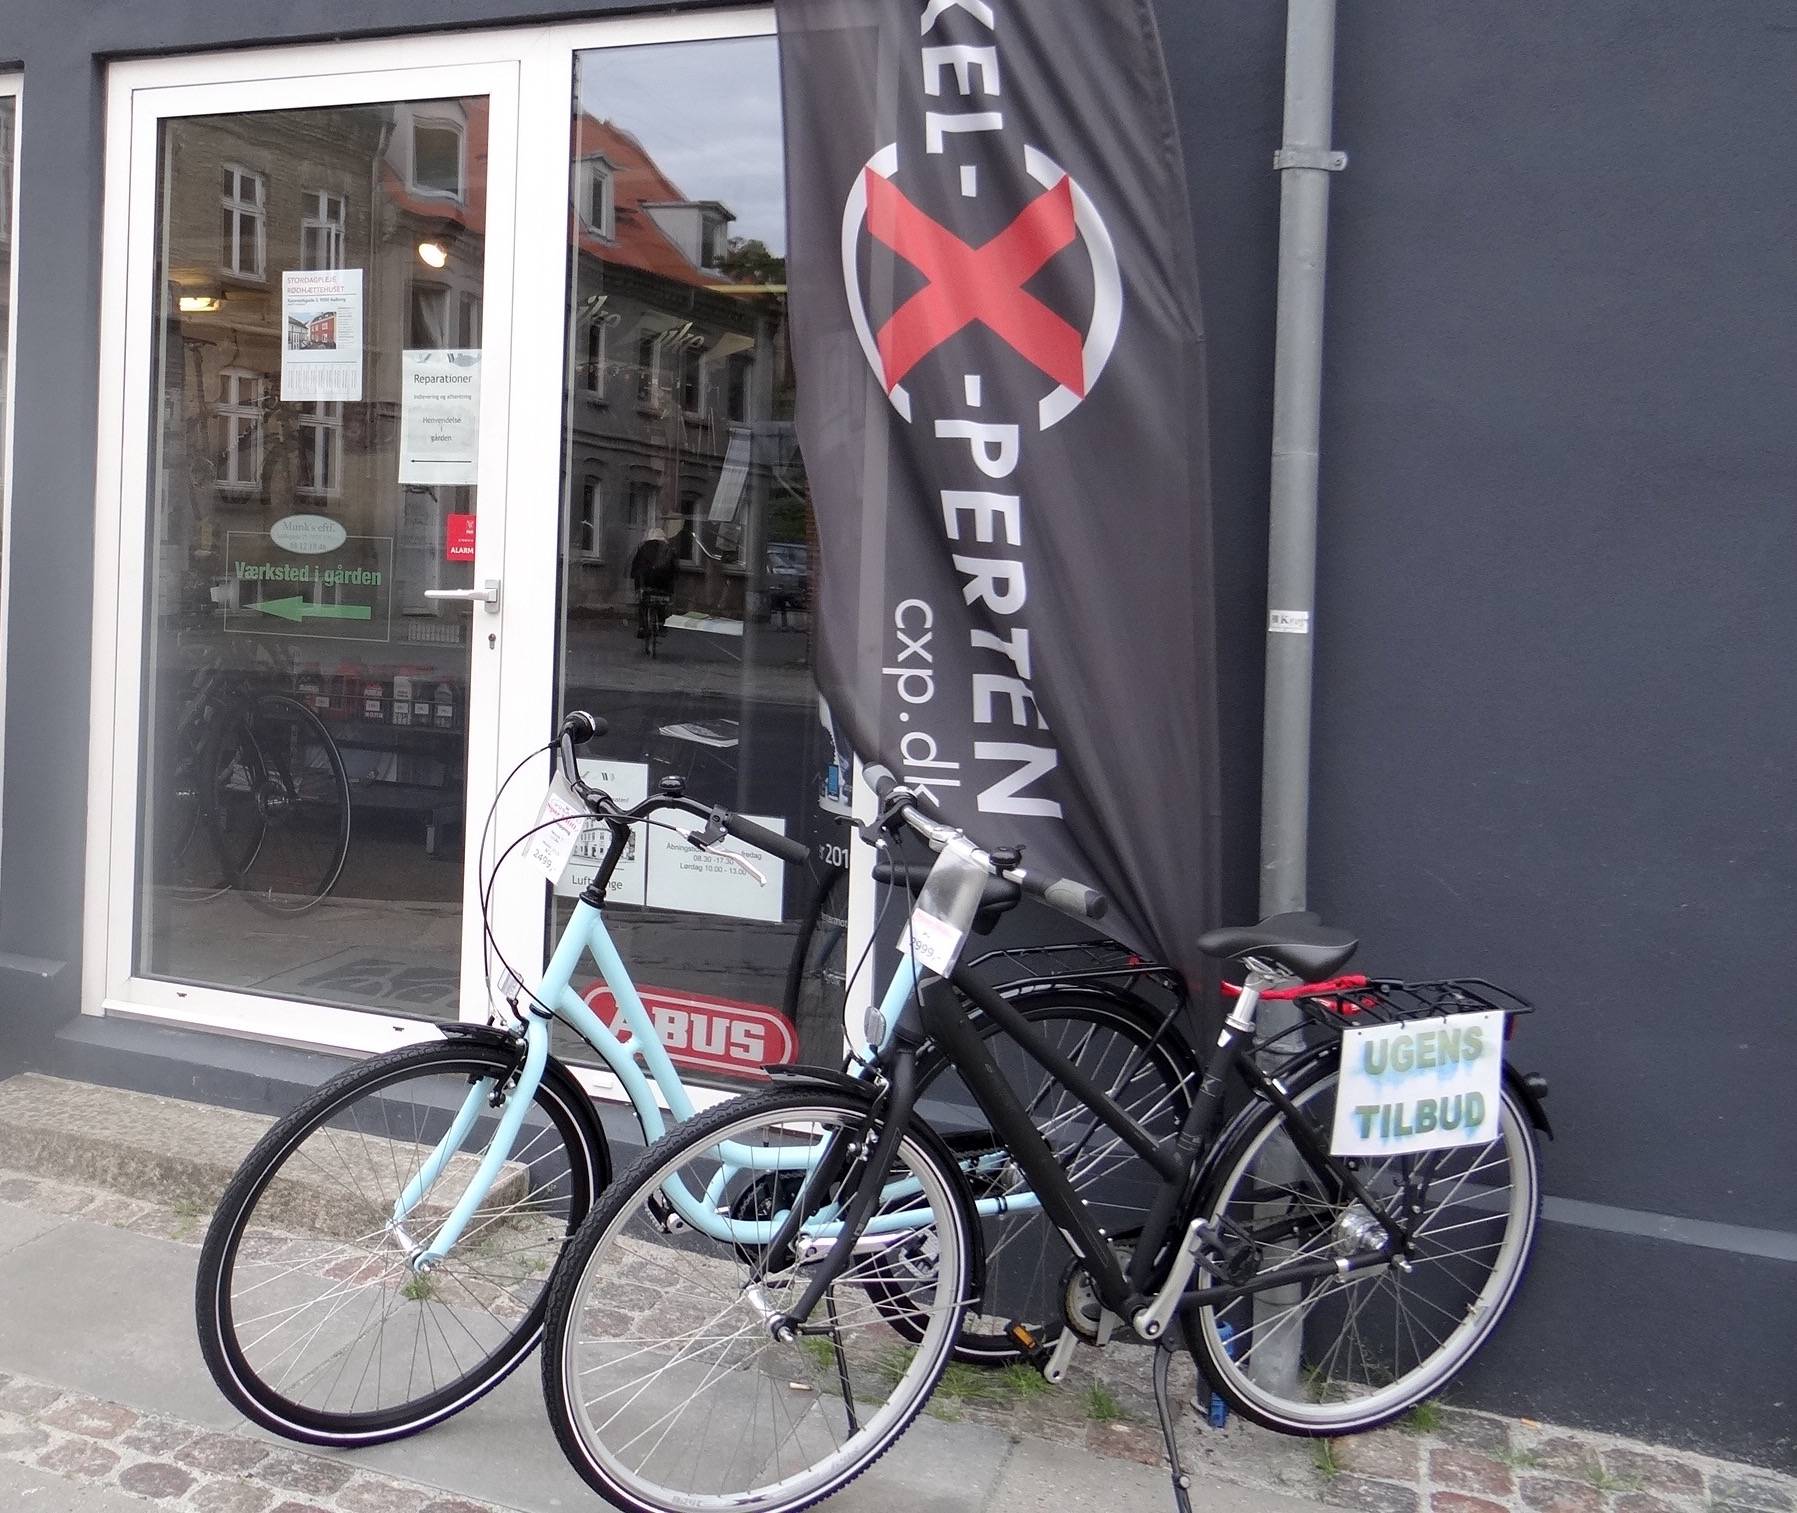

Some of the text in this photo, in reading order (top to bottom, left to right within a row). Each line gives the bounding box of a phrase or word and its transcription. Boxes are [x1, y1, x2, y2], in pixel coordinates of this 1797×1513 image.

[413, 373, 473, 386] Reparationer
[422, 416, 462, 424] Henvendelse
[430, 433, 453, 443] gården
[450, 546, 475, 555] ALARM
[235, 561, 309, 582] Værksted
[324, 564, 382, 587] gården
[679, 862, 703, 873] Lørdag
[572, 874, 623, 891] Luftnge
[1363, 1025, 1484, 1076] UGENS
[1354, 1091, 1486, 1139] TILBUD
